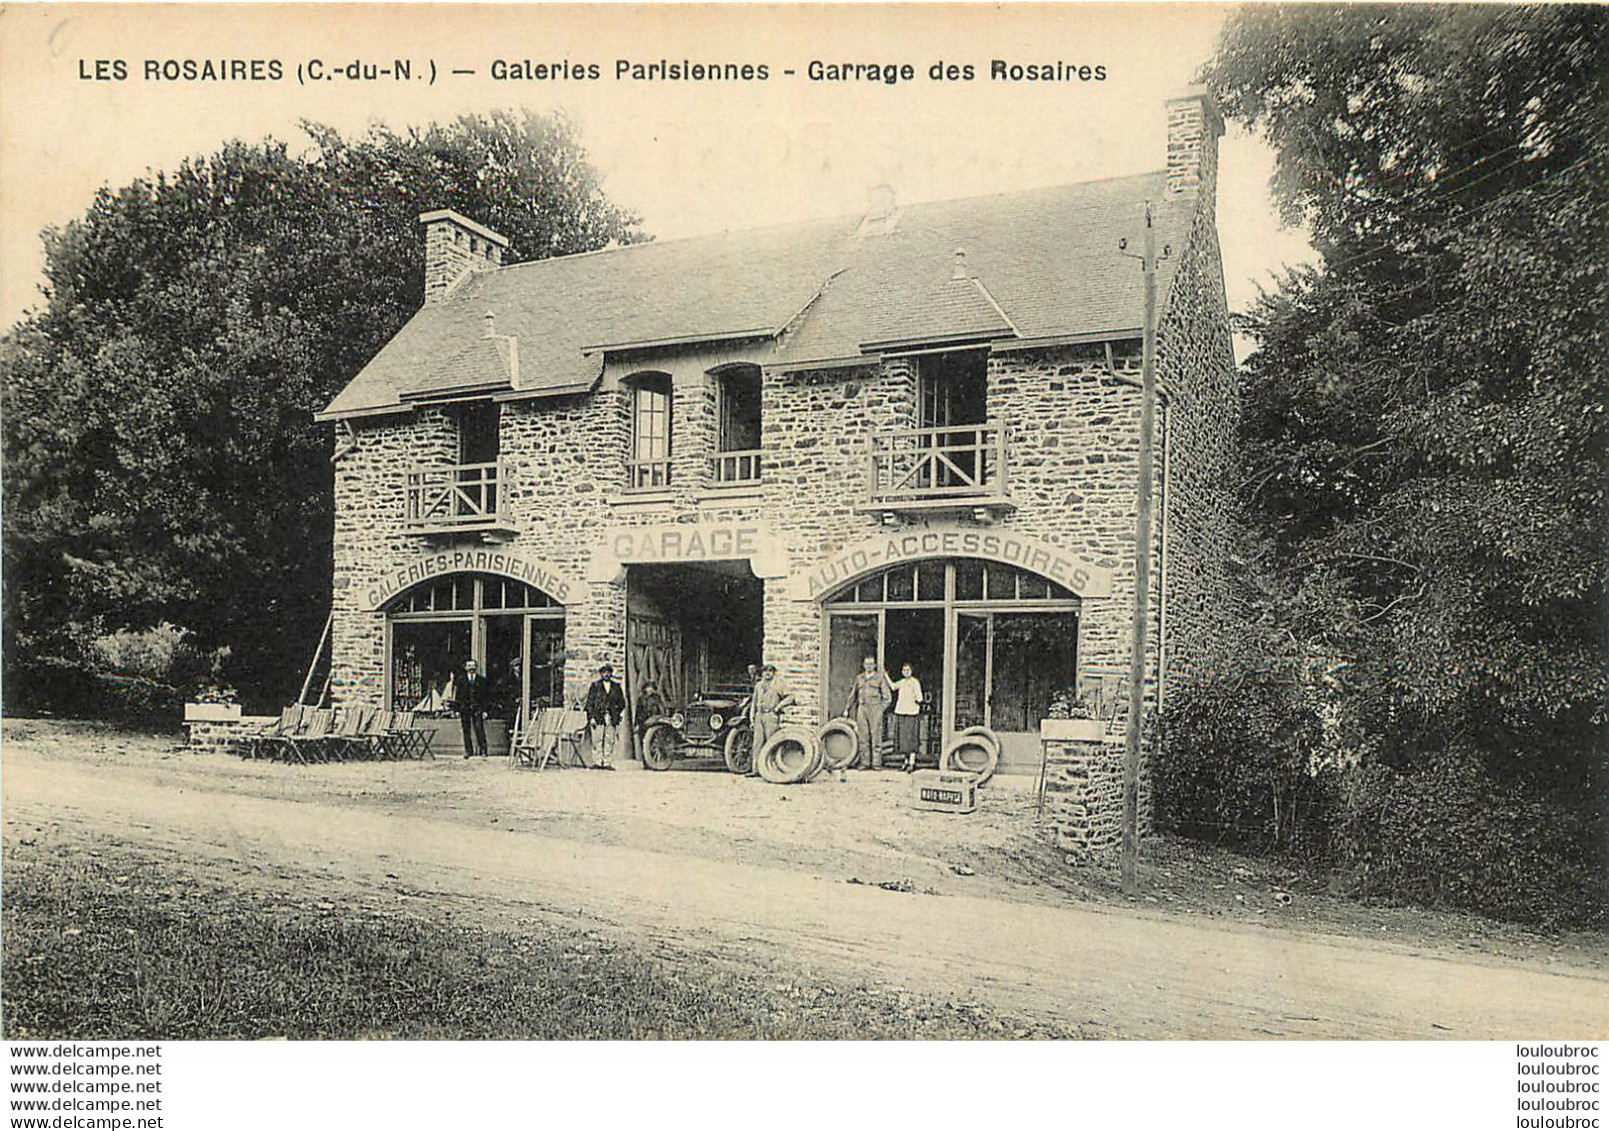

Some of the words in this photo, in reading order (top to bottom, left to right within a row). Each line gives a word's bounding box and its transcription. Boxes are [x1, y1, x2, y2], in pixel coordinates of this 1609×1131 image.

[612, 528, 758, 559] GARAGE
[808, 532, 1091, 596] AUTO-ACCESSOIRES
[367, 551, 571, 608] GALERIES-PARISIENNES
